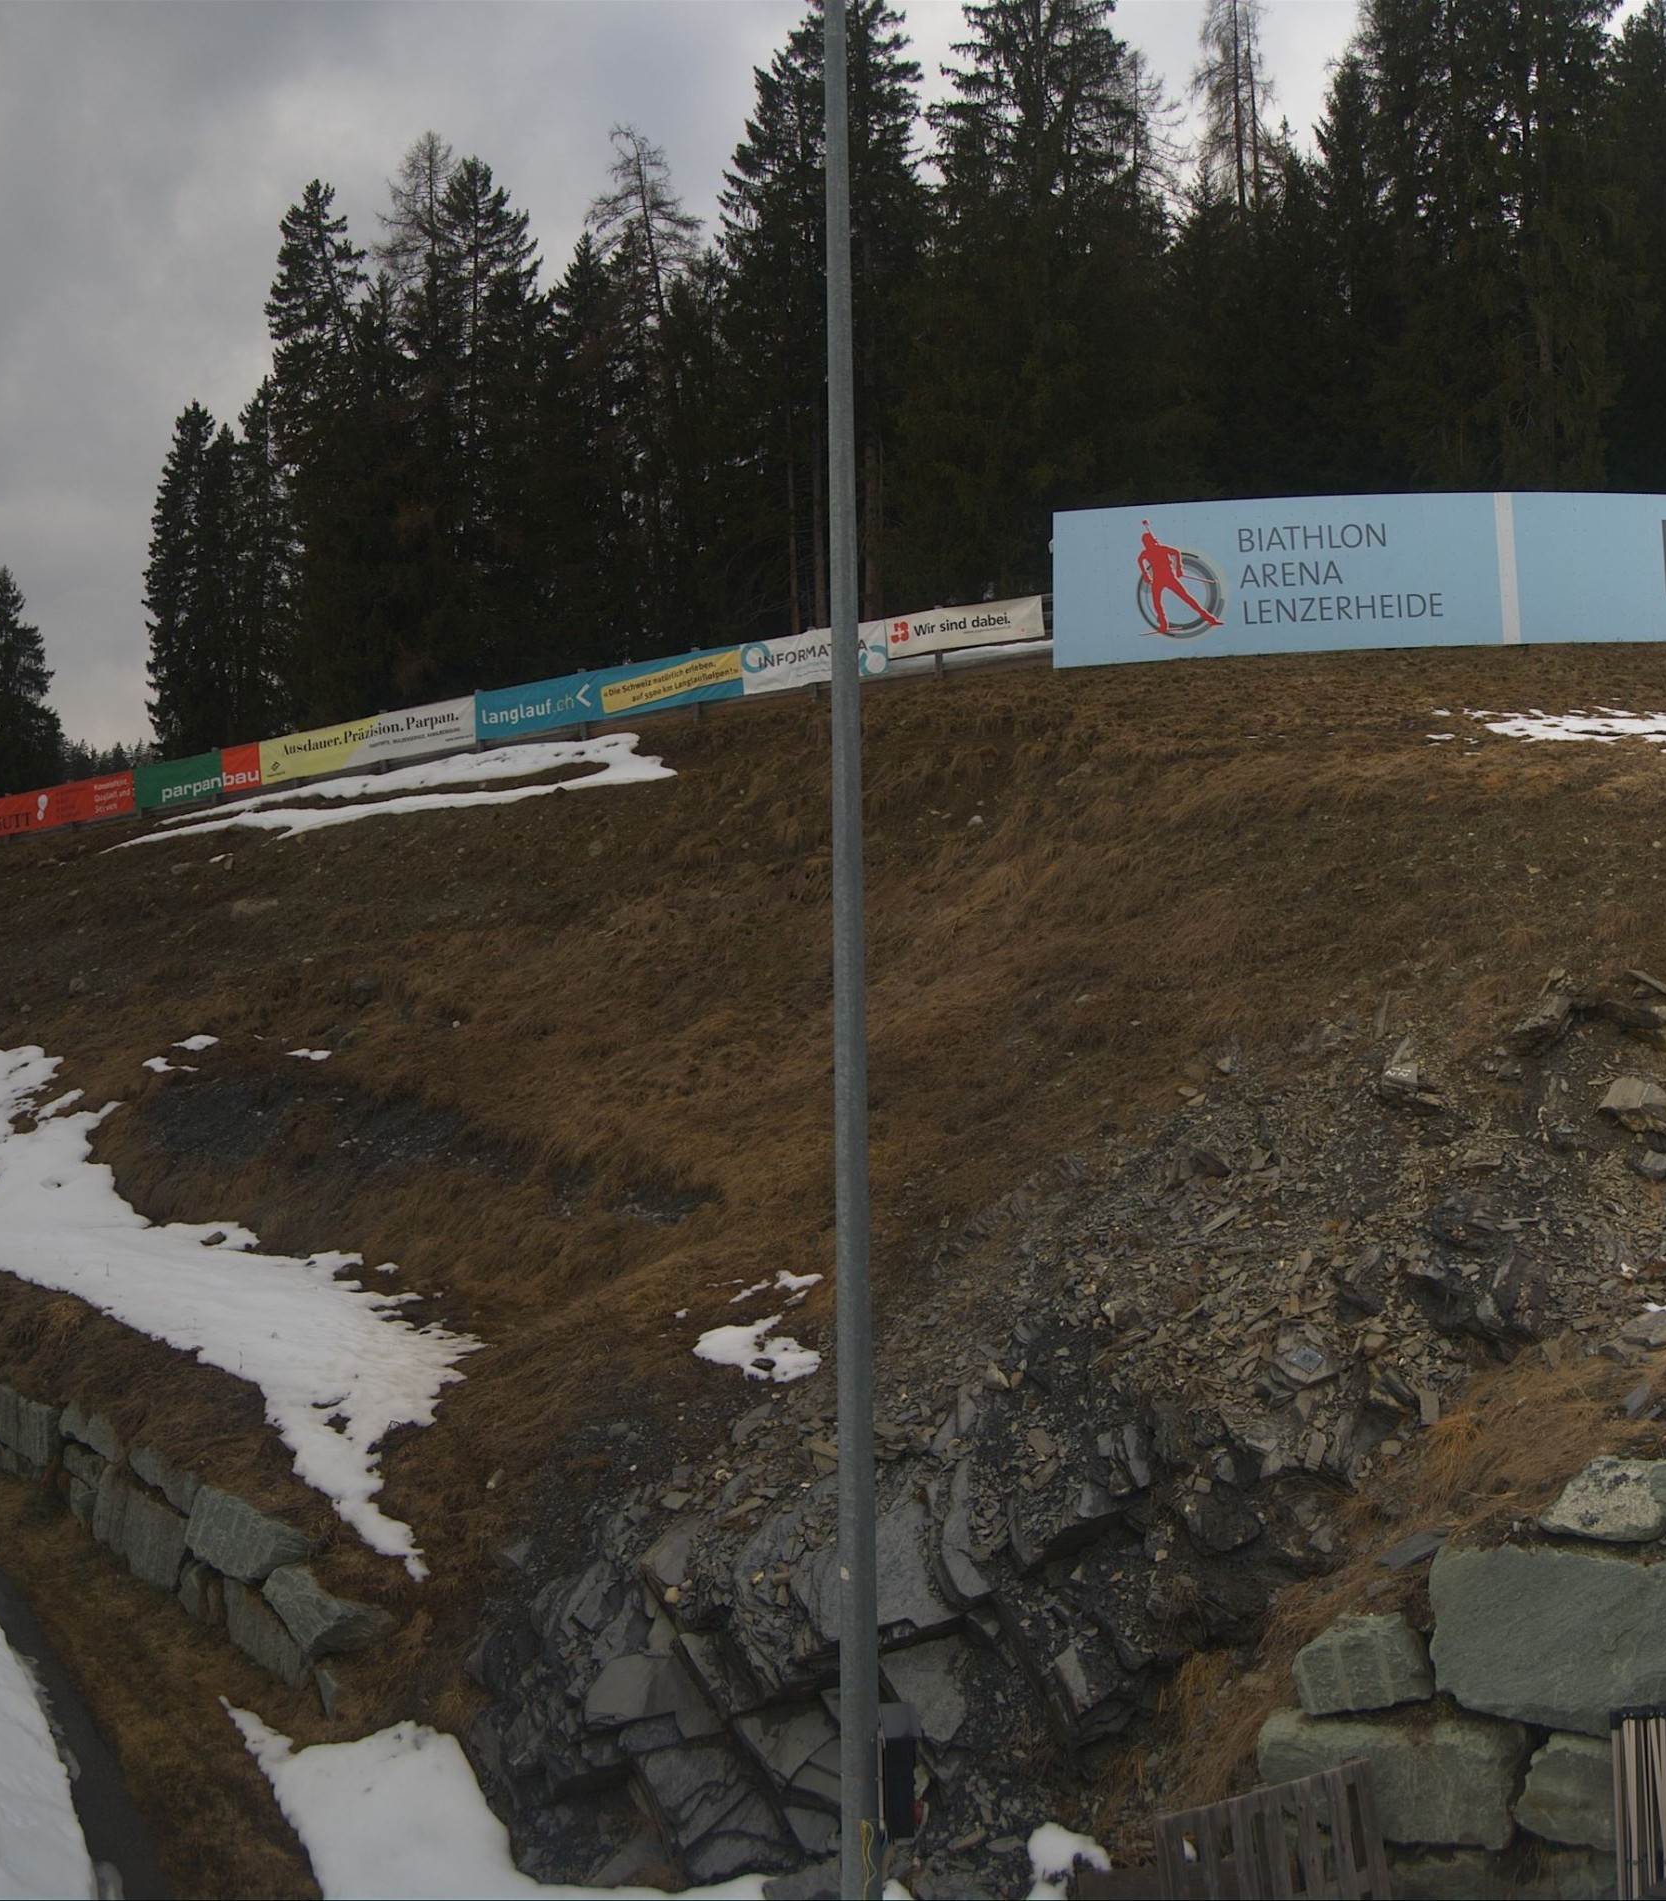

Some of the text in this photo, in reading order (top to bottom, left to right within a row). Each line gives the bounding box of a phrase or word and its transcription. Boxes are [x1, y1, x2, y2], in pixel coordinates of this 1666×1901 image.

[1237, 522, 1387, 553] BIATHLON
[1240, 560, 1343, 589] ARENA
[1243, 592, 1444, 625] LENZERHEIDE
[913, 622, 936, 637] Wir
[939, 617, 967, 633] sind
[971, 612, 1011, 629] dabei.
[758, 639, 869, 669] INFORMAA
[621, 678, 652, 694] Schweiz
[653, 669, 684, 685] natürlich
[632, 691, 644, 702] auf
[662, 683, 674, 695] km
[481, 693, 575, 726] langlauf.ch
[283, 710, 459, 757] Ausdauer. Präzision. Parpan.
[161, 769, 260, 803] parpanbau
